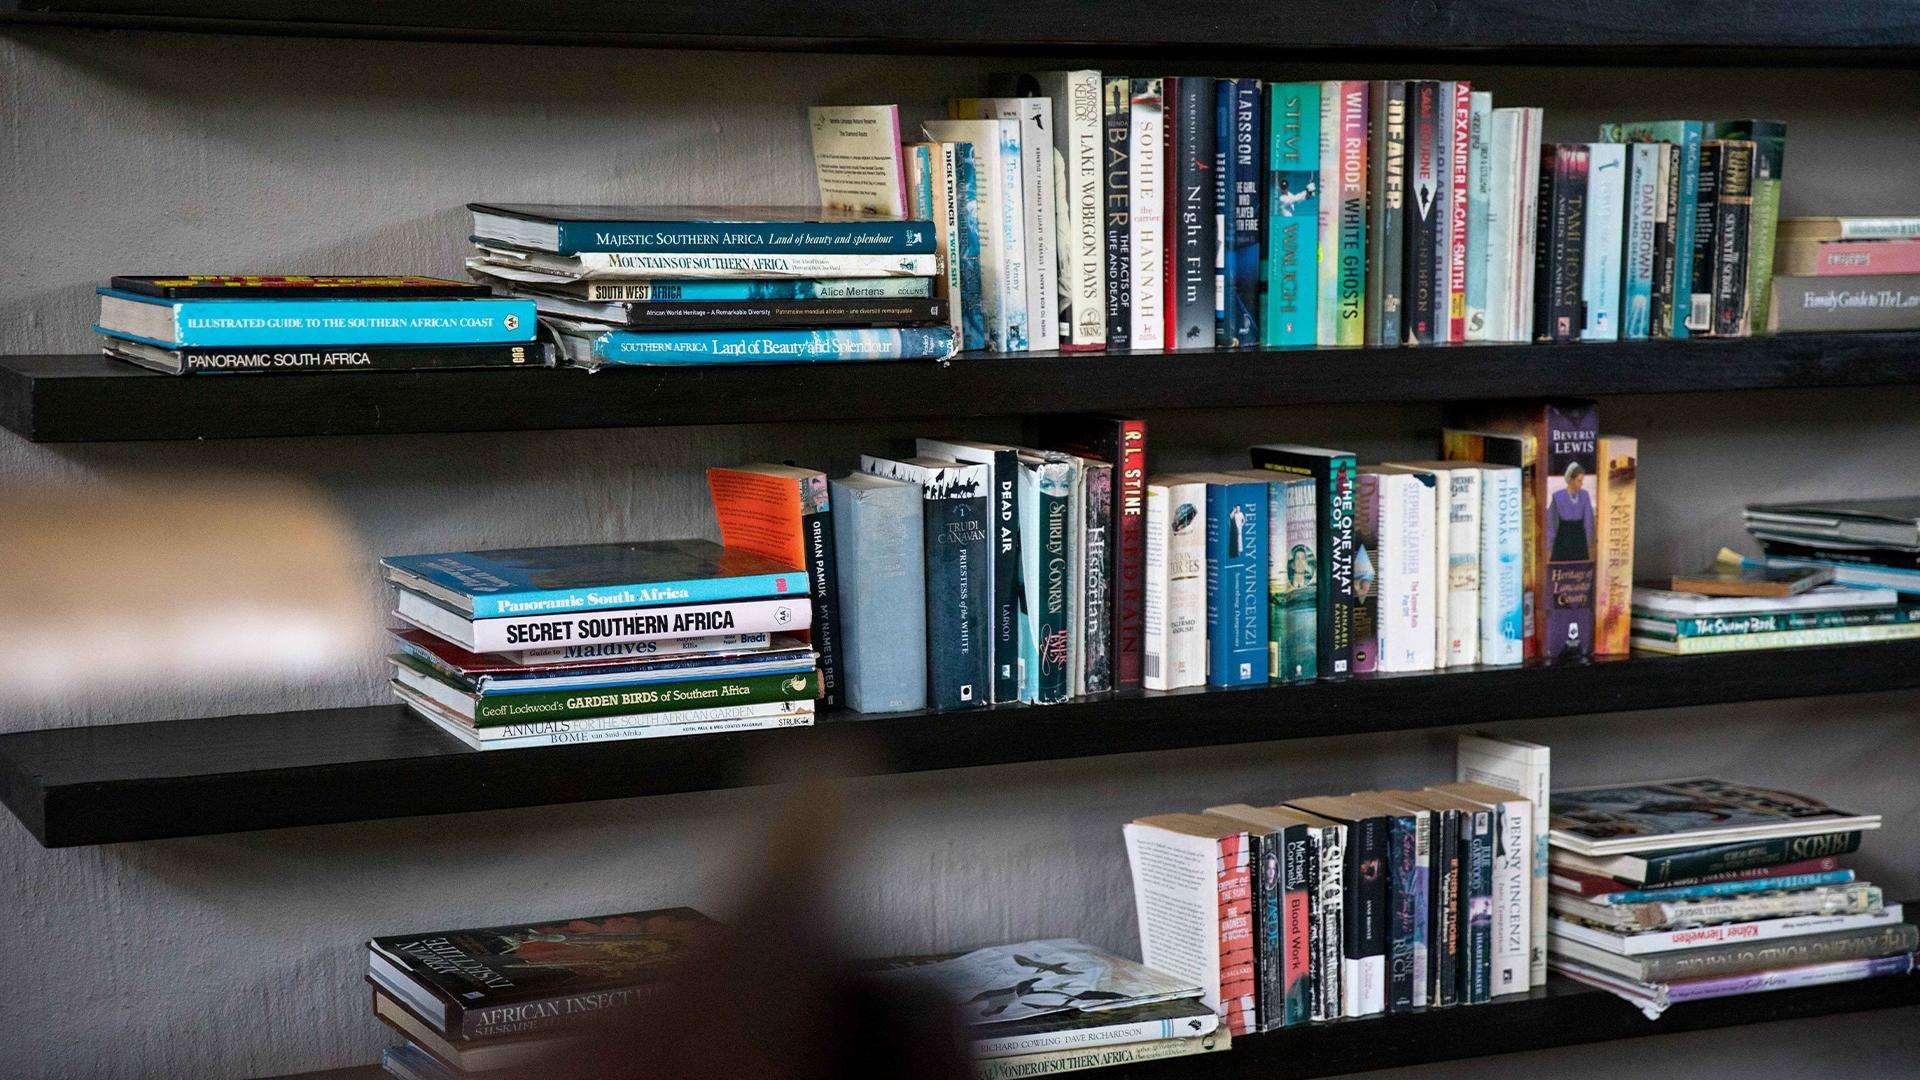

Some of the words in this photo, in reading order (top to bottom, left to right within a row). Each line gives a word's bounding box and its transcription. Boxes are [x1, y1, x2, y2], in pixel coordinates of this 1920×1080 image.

[1074, 84, 1088, 123] KEILLOR
[1346, 92, 1362, 132] WILL
[1237, 90, 1254, 166] LARSSON
[1284, 96, 1300, 163] STEVE
[945, 150, 953, 178] DICK
[1081, 135, 1094, 178] LAKE
[1139, 121, 1154, 200] SOPHIE
[1345, 137, 1361, 193] RHODE
[946, 180, 956, 227] FRANCIS
[1183, 185, 1202, 247] Night
[1557, 194, 1566, 237] ASHES
[1643, 183, 1654, 216] DAN
[1082, 183, 1097, 257] WOBEGON
[1344, 198, 1360, 251] WHITE
[1568, 194, 1583, 242] TAMI
[595, 232, 654, 247] MAJESTIC
[655, 231, 719, 246] SOUTHERN
[722, 231, 764, 246] AFRICA
[769, 233, 793, 246] Land
[794, 233, 806, 249] of
[806, 233, 833, 249] beauty
[834, 233, 850, 246] and
[853, 233, 894, 249] splendour
[950, 230, 958, 264] TWICE
[1109, 231, 1118, 257] LIFE
[1119, 234, 1129, 256] THE
[1557, 243, 1565, 260] TO
[1639, 220, 1653, 280] BROWN
[608, 253, 678, 270] MOUNTAINS
[678, 257, 692, 270] OF
[691, 257, 750, 271] SOUTHERN
[752, 257, 790, 271] AFRICA
[951, 266, 959, 289] SHY
[1109, 260, 1118, 282] AND
[1119, 258, 1129, 289] FACTS
[1140, 231, 1155, 319] HANNAH
[1564, 247, 1582, 308] HOAG
[595, 285, 624, 300] SOUTH
[625, 285, 650, 300] WEST
[651, 285, 683, 300] AFRICA
[820, 286, 845, 298] Alice
[846, 286, 886, 298] Mertens
[1084, 264, 1098, 300] DAYS
[1186, 256, 1202, 303] Film
[1342, 256, 1359, 321] GHOSTS
[1554, 263, 1564, 308] ASHES
[646, 308, 667, 317] African
[667, 308, 684, 317] World
[684, 308, 707, 318] Heritage
[716, 308, 748, 317] Remarkable
[749, 308, 771, 318] Diversity
[1039, 310, 1046, 319] TO
[1109, 285, 1118, 317] DEATH
[1119, 293, 1129, 308] OF
[1803, 291, 1838, 312] Family
[1838, 290, 1868, 308] Guide
[1878, 290, 1896, 308] The
[187, 317, 266, 329] ILLUSTRATED
[266, 317, 304, 329] GUIDE
[305, 317, 322, 329] TO
[322, 318, 347, 328] THE
[347, 318, 409, 328] SOUTHERN
[410, 318, 460, 329] AFRICAN
[460, 317, 495, 329] COAST
[187, 355, 272, 369] PANORAMIC
[273, 353, 321, 367] SOUTH
[323, 352, 372, 366] AFRICA
[620, 341, 671, 353] SOUTHERN
[672, 341, 708, 353] AFRICA
[711, 338, 741, 356] Land
[743, 338, 760, 355] of
[762, 338, 806, 358] Beauty
[830, 338, 892, 357] Splendour
[1124, 430, 1143, 465] R.L.
[1554, 441, 1595, 454] LEWIS
[1001, 480, 1013, 521] DEAD
[1123, 469, 1142, 516] STINE
[1342, 481, 1353, 511] THE
[948, 520, 979, 533] TRUDI
[1047, 501, 1066, 557] SHIRLEY
[1332, 496, 1342, 530] GOT
[812, 520, 823, 558] ORHAN
[937, 529, 985, 545] CANAVAN
[1001, 526, 1012, 555] AIR
[1244, 502, 1257, 560] PENNY
[1341, 516, 1353, 550] ONE
[1608, 504, 1622, 569] KEEPER
[1332, 536, 1342, 582] AWAY
[1341, 555, 1352, 596] THAT
[815, 560, 827, 598] PAMUK
[1047, 557, 1067, 615] CONRAN
[1088, 525, 1105, 636] Historian
[496, 593, 586, 613] Panoramic
[587, 590, 637, 606] South
[638, 588, 690, 604] Africa
[820, 604, 829, 620] MY
[1244, 564, 1257, 646] VINCENZI
[506, 620, 574, 644] SECRET
[577, 614, 669, 640] SOUTHERN
[672, 609, 736, 634] AFRICA
[821, 621, 831, 652] NAME
[529, 649, 549, 657] Guide
[563, 640, 657, 659] Maldives
[823, 654, 832, 665] IS
[825, 667, 834, 689] RED
[482, 704, 508, 717] Geoff
[508, 700, 565, 714] Lockwood's
[566, 695, 620, 711] GARDEN
[621, 691, 659, 706] BIRDS
[660, 690, 672, 703] of
[673, 687, 719, 700] Southern
[720, 684, 751, 698] Africa
[1509, 816, 1521, 870] PENNY
[1792, 831, 1850, 857] BIRDS
[1286, 842, 1296, 890] Connelly
[1295, 840, 1306, 885] Michael
[1442, 872, 1450, 906] Virginia
[1449, 866, 1458, 900] THERE
[1291, 898, 1301, 935] Blood
[1449, 900, 1457, 914] BE
[1509, 874, 1521, 953] VINCENZI
[1441, 907, 1450, 943] Andrews
[1447, 914, 1457, 956] THORNS
[1672, 929, 1724, 944] Tierwelten
[1291, 937, 1301, 971] Work
[1393, 938, 1405, 983] RICE
[477, 1000, 560, 1026] AFRICAN
[566, 989, 632, 1014] INSECT
[980, 1039, 1020, 1054] RICHARD
[1020, 1036, 1062, 1049] COWLING
[1064, 1035, 1087, 1045] DAVE
[1087, 1028, 1142, 1042] RICHARDSON
